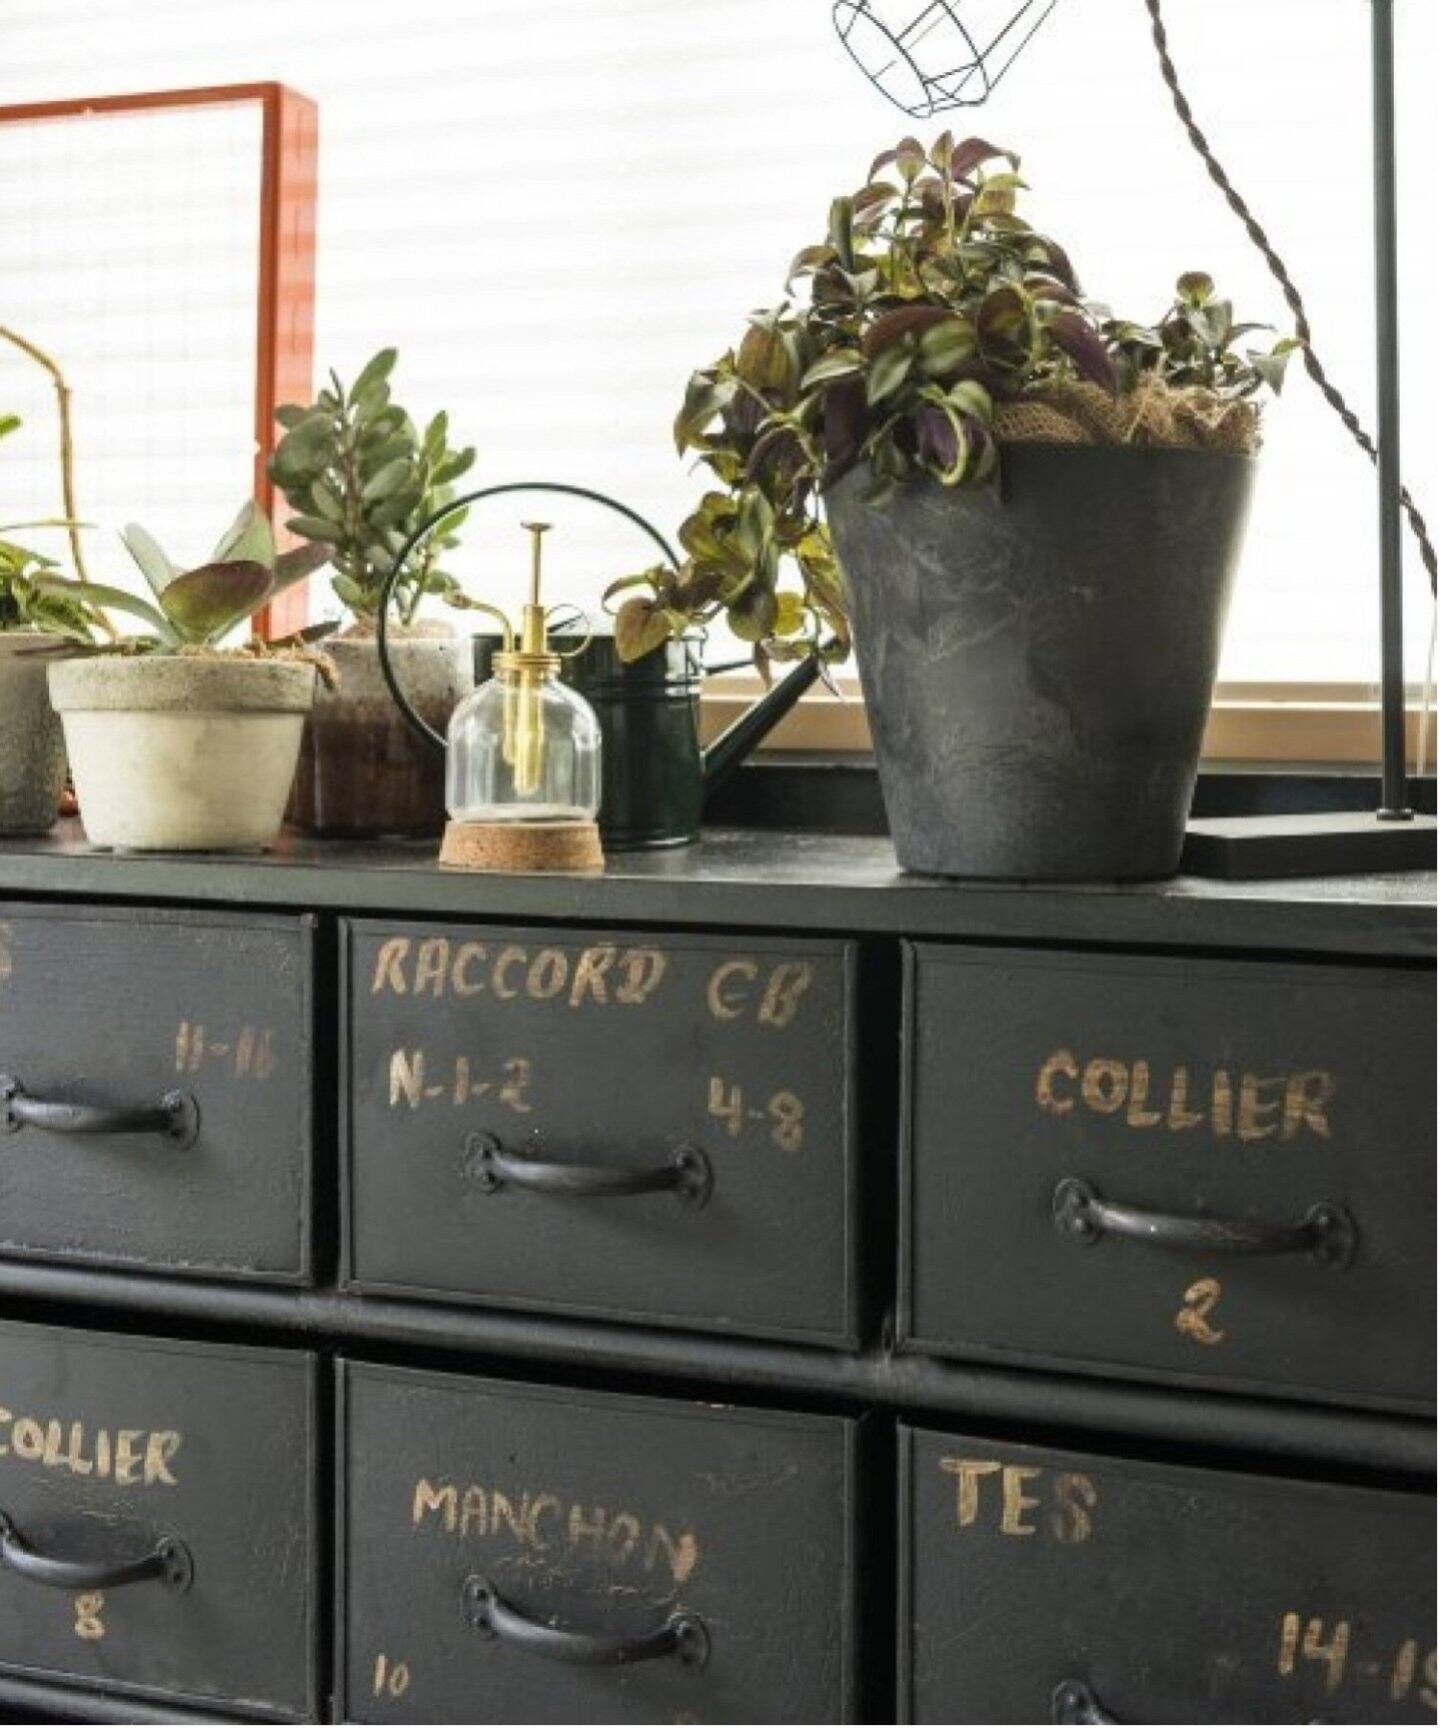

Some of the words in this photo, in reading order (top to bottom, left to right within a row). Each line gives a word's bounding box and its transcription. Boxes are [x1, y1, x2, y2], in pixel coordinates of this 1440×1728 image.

[371, 936, 667, 1007] RACCORD
[707, 1075, 804, 1150] 4-8
[1036, 1049, 1337, 1141] COLLIER
[1175, 1277, 1226, 1345] 2
[411, 1477, 699, 1583] MANCHON
[939, 1456, 1098, 1543] TES
[73, 1590, 106, 1640] 8
[372, 1652, 411, 1697] 10
